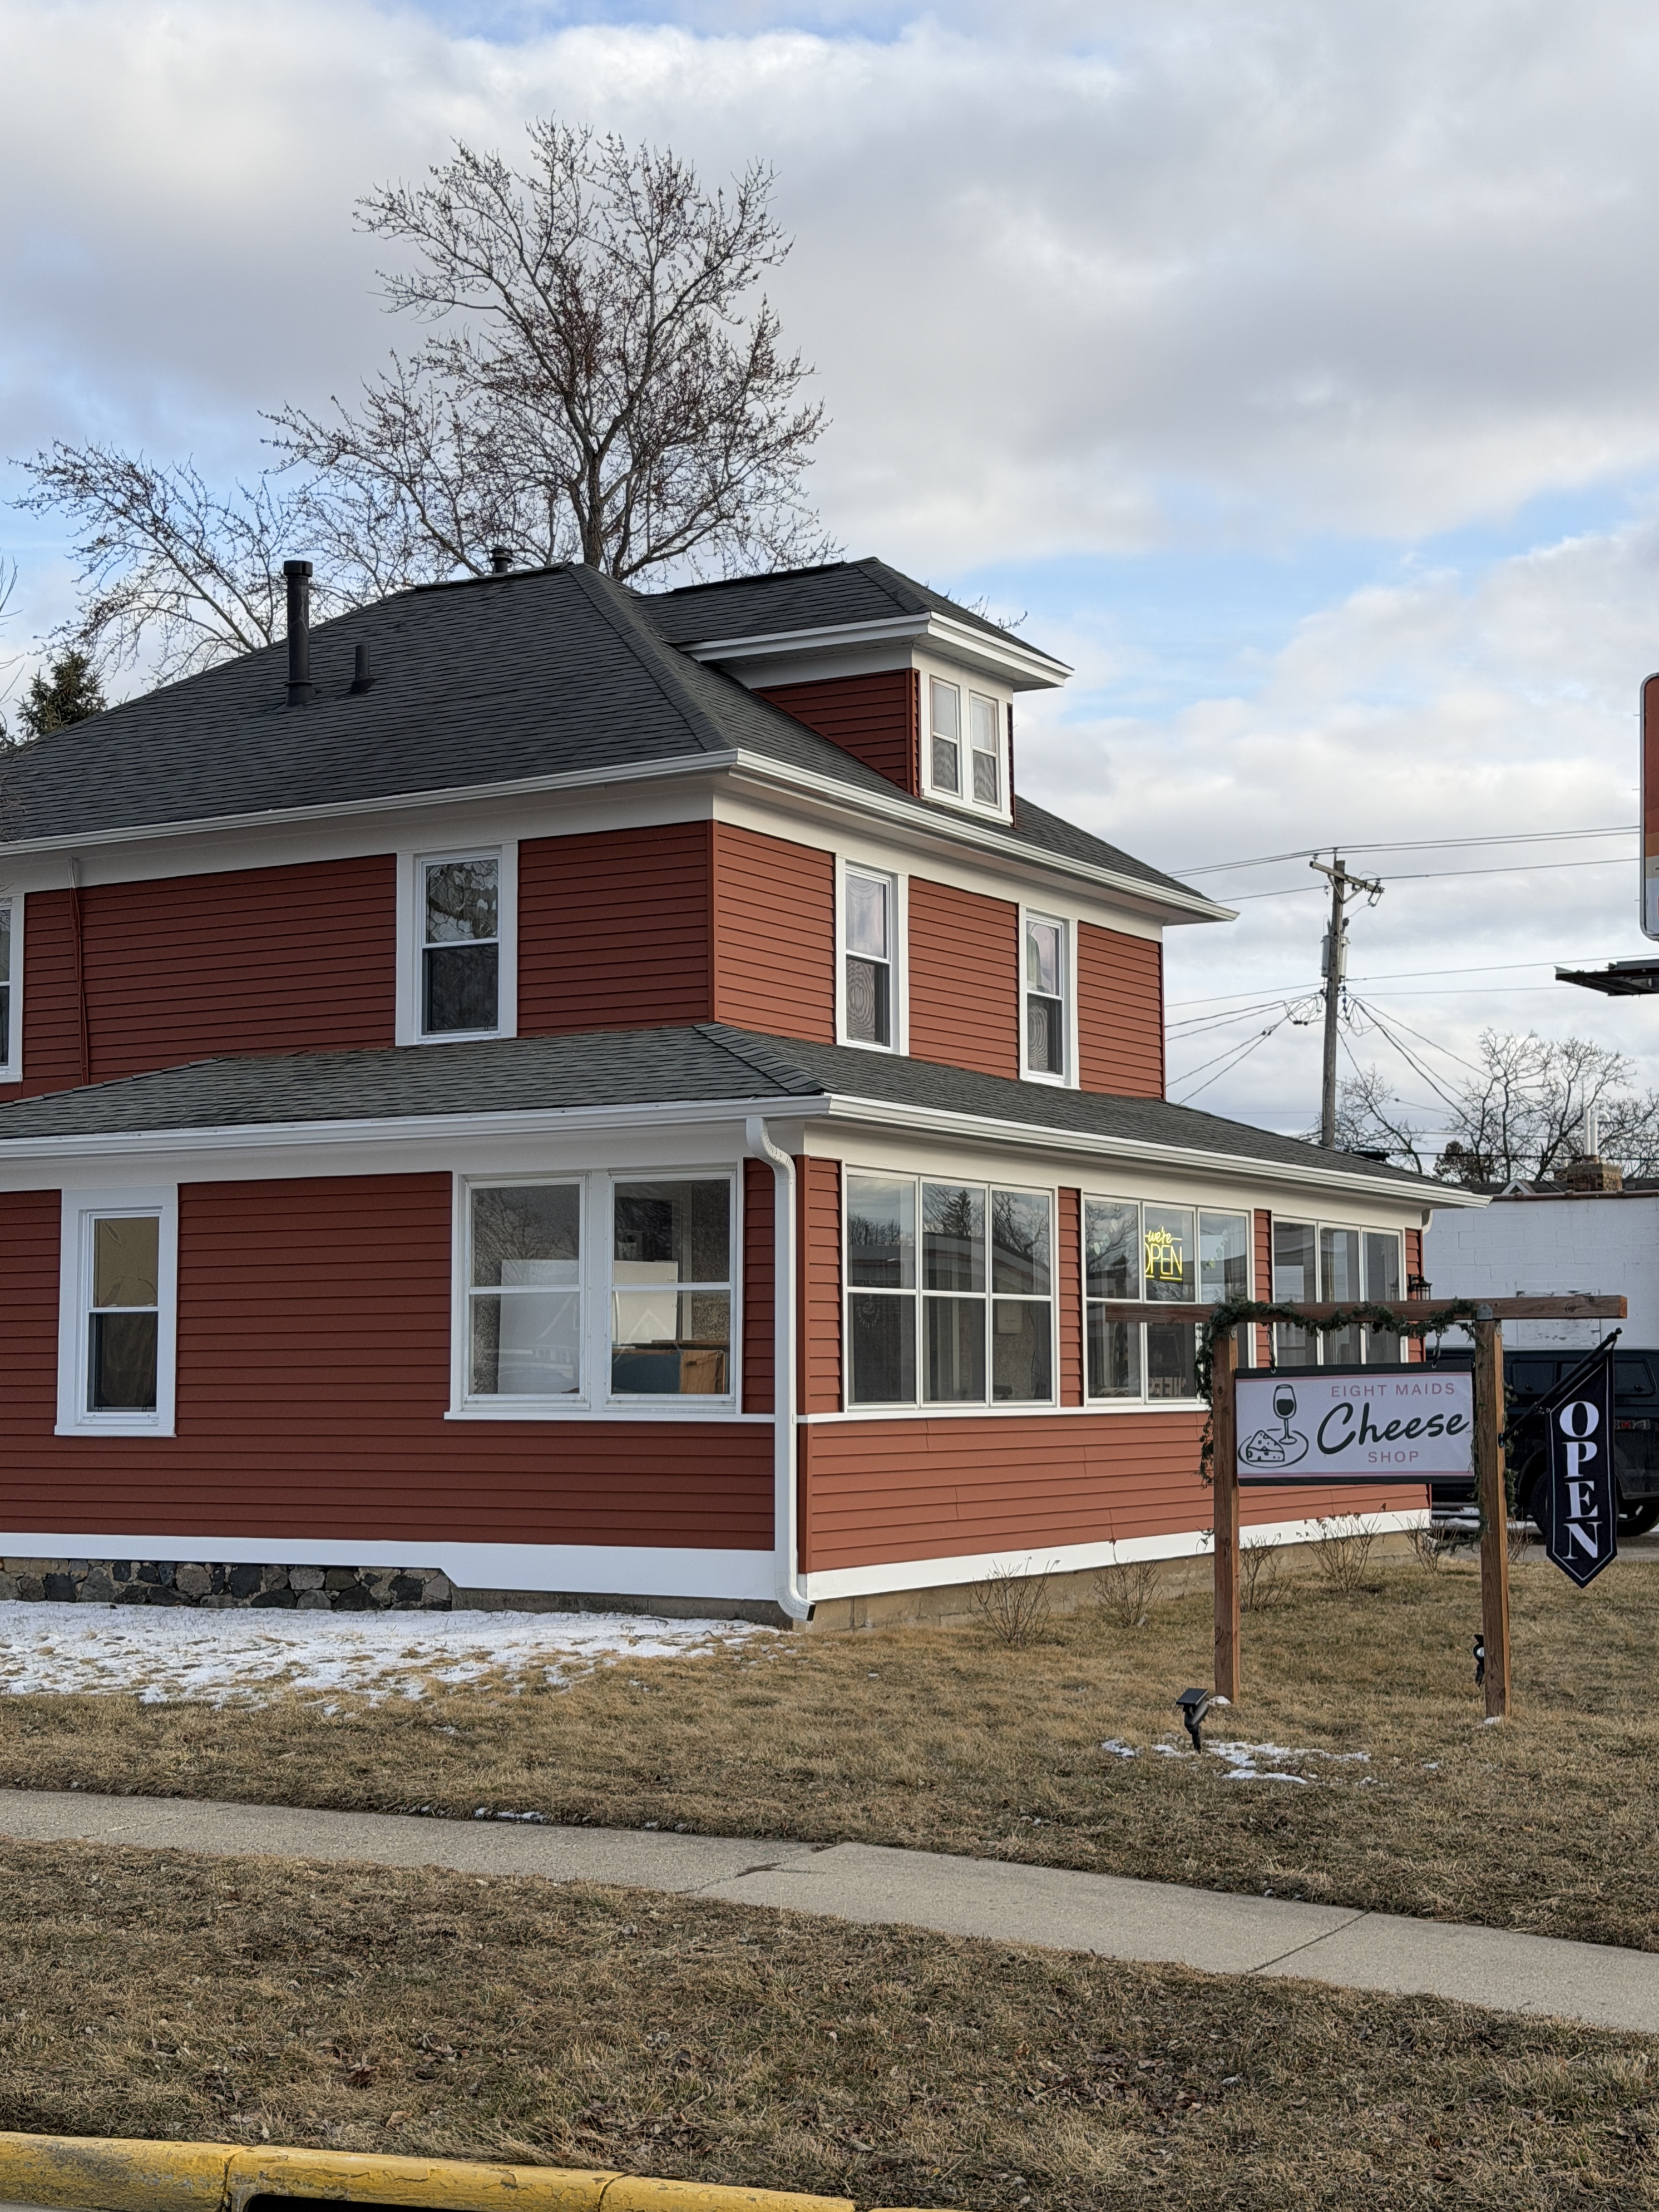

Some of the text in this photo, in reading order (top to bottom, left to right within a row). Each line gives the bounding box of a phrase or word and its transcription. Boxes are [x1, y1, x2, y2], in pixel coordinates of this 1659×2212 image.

[1148, 1226, 1173, 1244] we're
[1331, 1383, 1455, 1397] EIGHT MAIDS
[1317, 1401, 1470, 1455] Cheese
[1368, 1450, 1419, 1463] SHOP
[1559, 1400, 1603, 1559] OPEN
